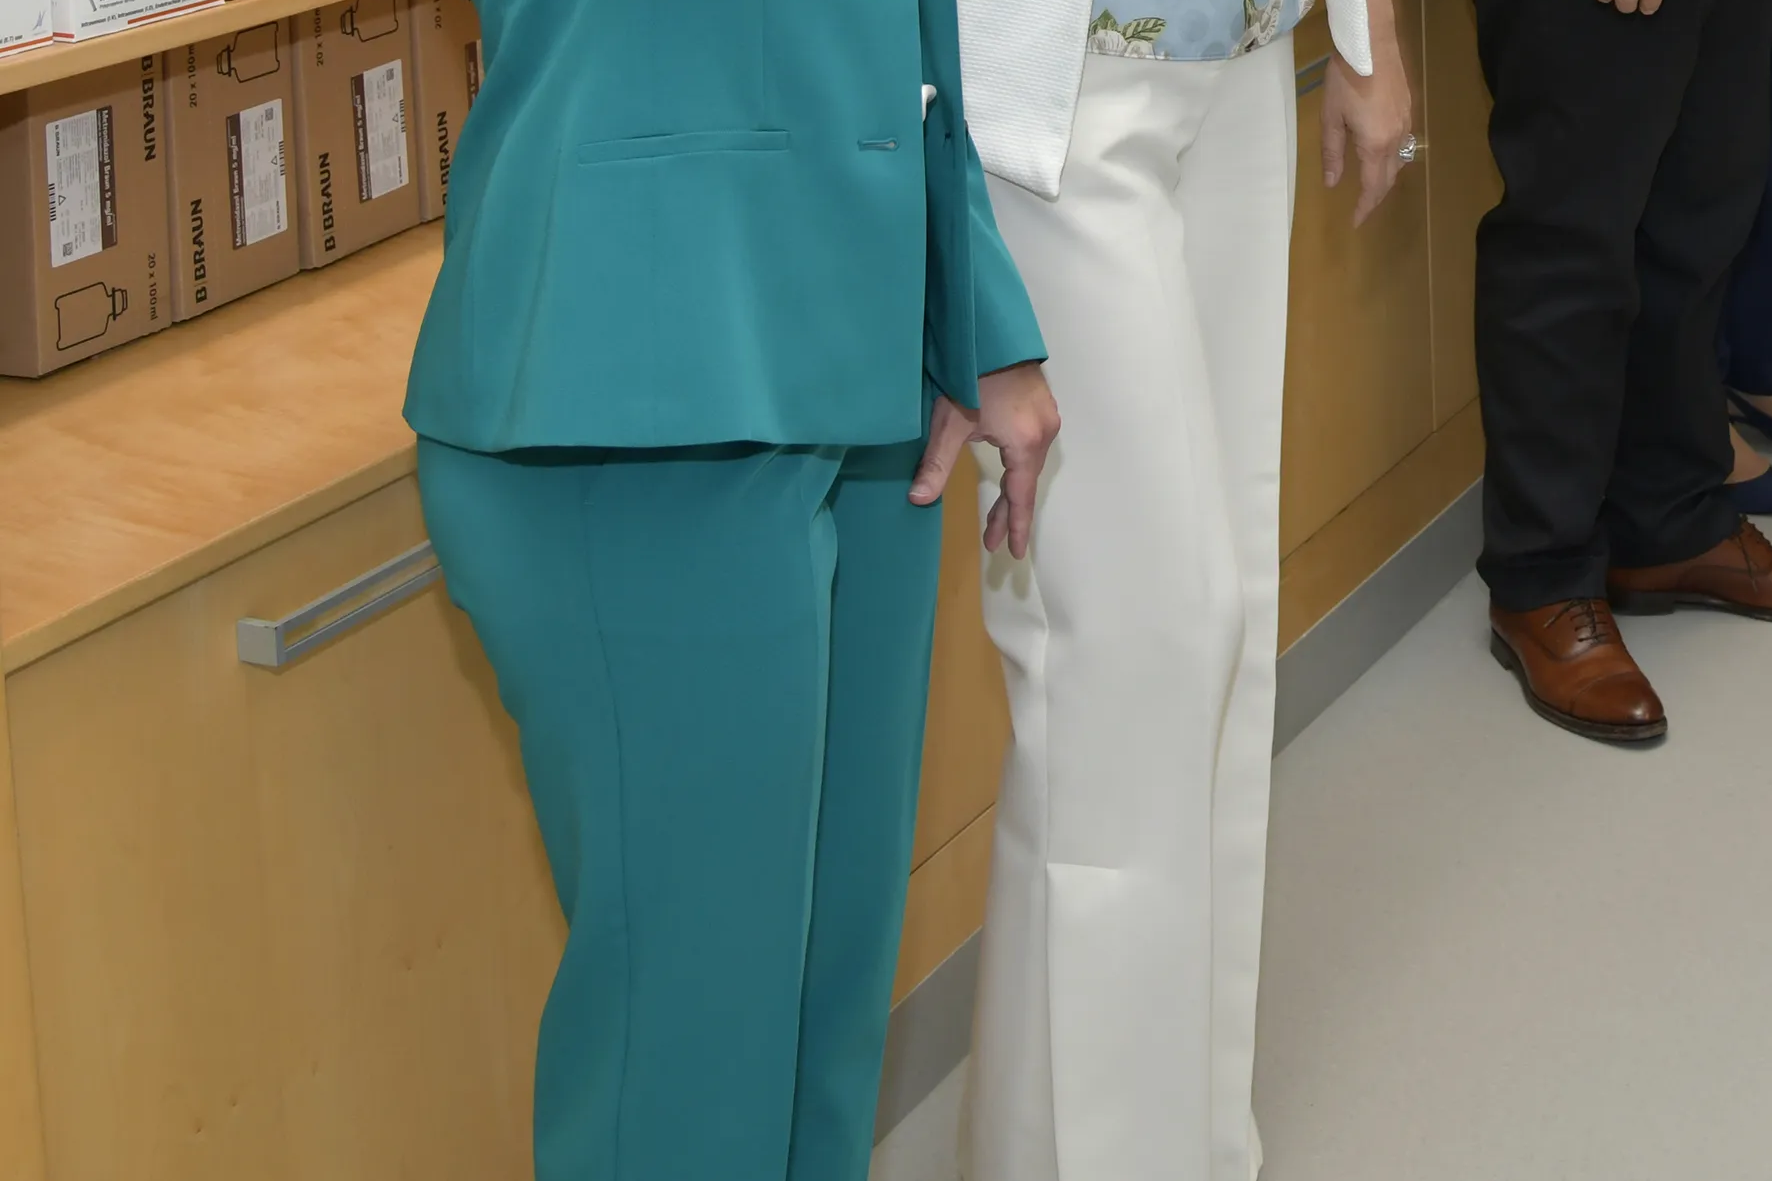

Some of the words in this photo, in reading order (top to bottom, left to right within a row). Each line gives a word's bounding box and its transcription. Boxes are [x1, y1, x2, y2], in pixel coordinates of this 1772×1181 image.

[316, 53, 324, 67] 20
[191, 83, 197, 91] x
[188, 95, 198, 108] 20
[142, 78, 156, 163] BRAUN
[101, 109, 110, 163] Metronidazol
[318, 152, 335, 231] BRAUN
[104, 200, 114, 227] mg/ml
[234, 195, 242, 246] Metronidazol
[190, 198, 207, 281] BRAUN
[325, 235, 336, 253] B
[148, 253, 156, 267] 20
[150, 271, 155, 279] x
[196, 285, 207, 303] B
